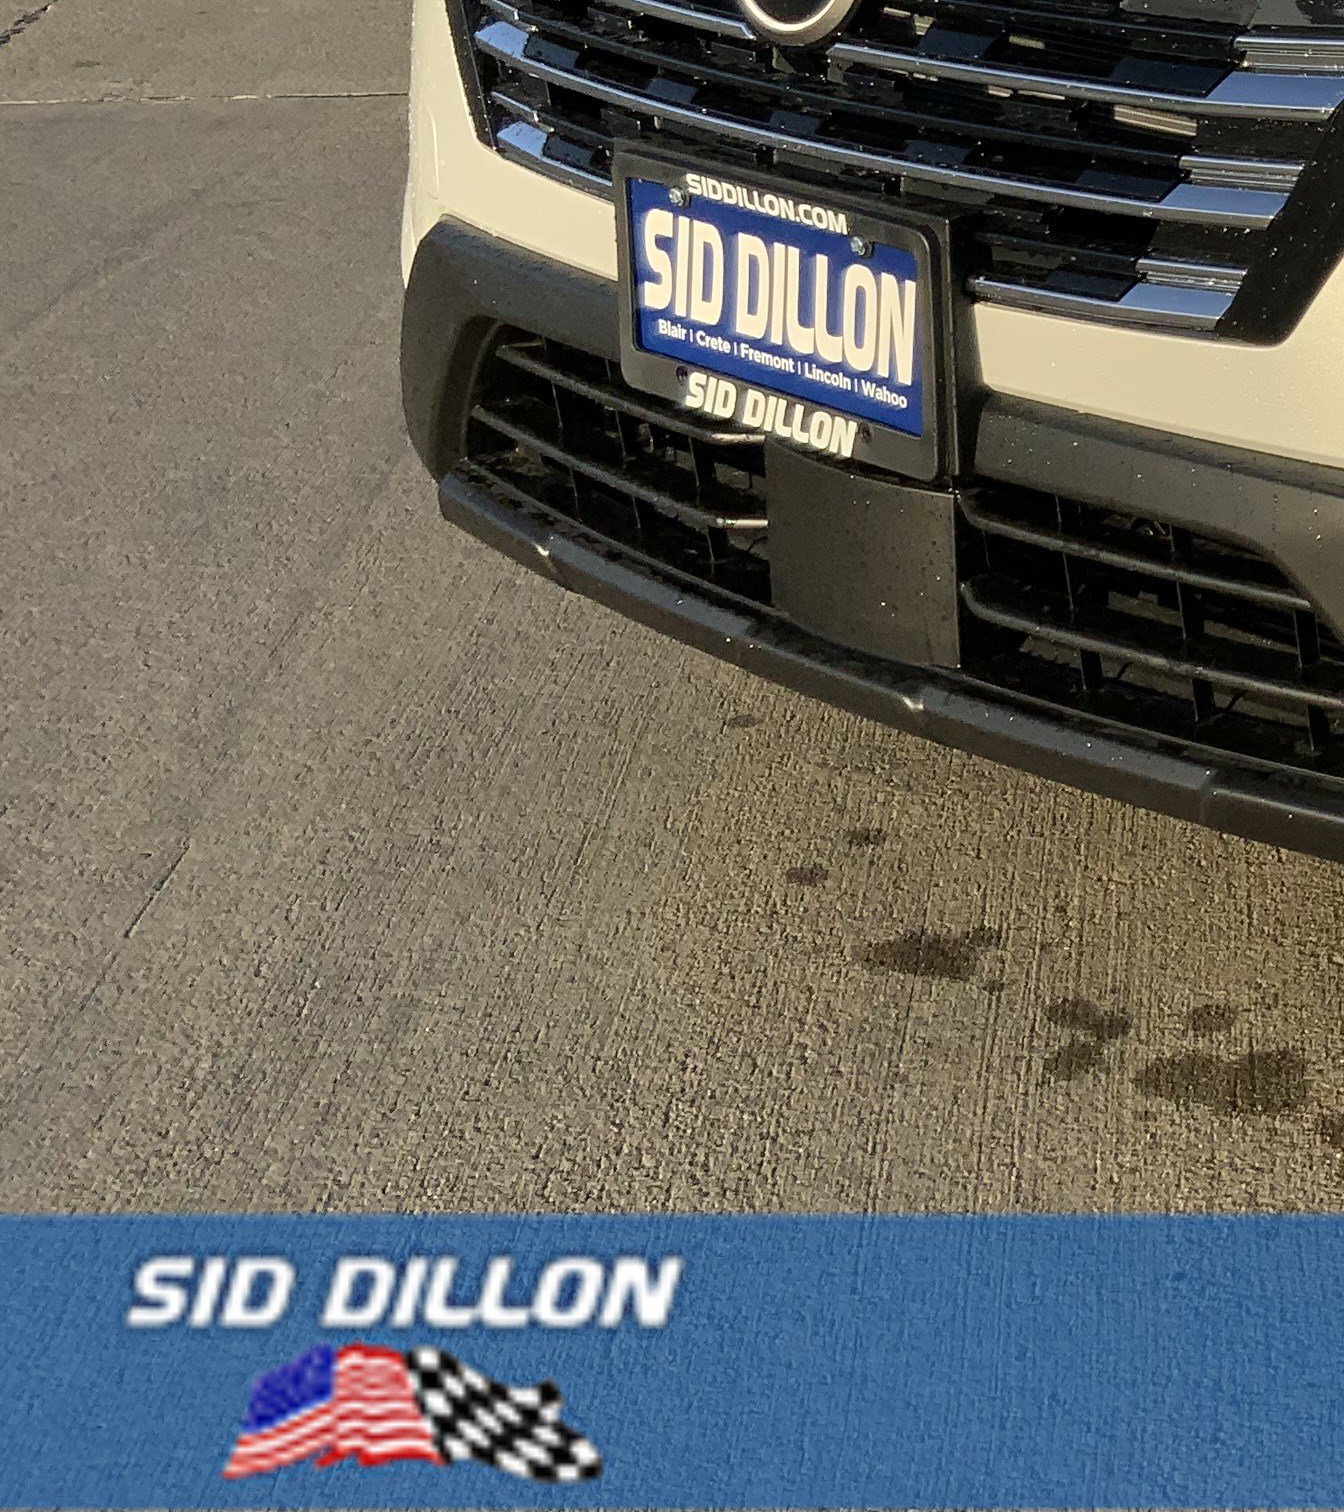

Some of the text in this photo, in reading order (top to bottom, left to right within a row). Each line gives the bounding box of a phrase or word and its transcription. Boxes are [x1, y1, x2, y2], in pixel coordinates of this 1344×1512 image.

[685, 172, 849, 236] SIDDILLON.COM
[644, 208, 917, 387] SID DILLON
[657, 318, 688, 341] Blair
[695, 329, 732, 355] Crete
[740, 343, 795, 374] Fremont
[804, 361, 852, 391] Lincoln
[861, 378, 908, 409] Wahoo
[685, 371, 858, 459] SID DILLON
